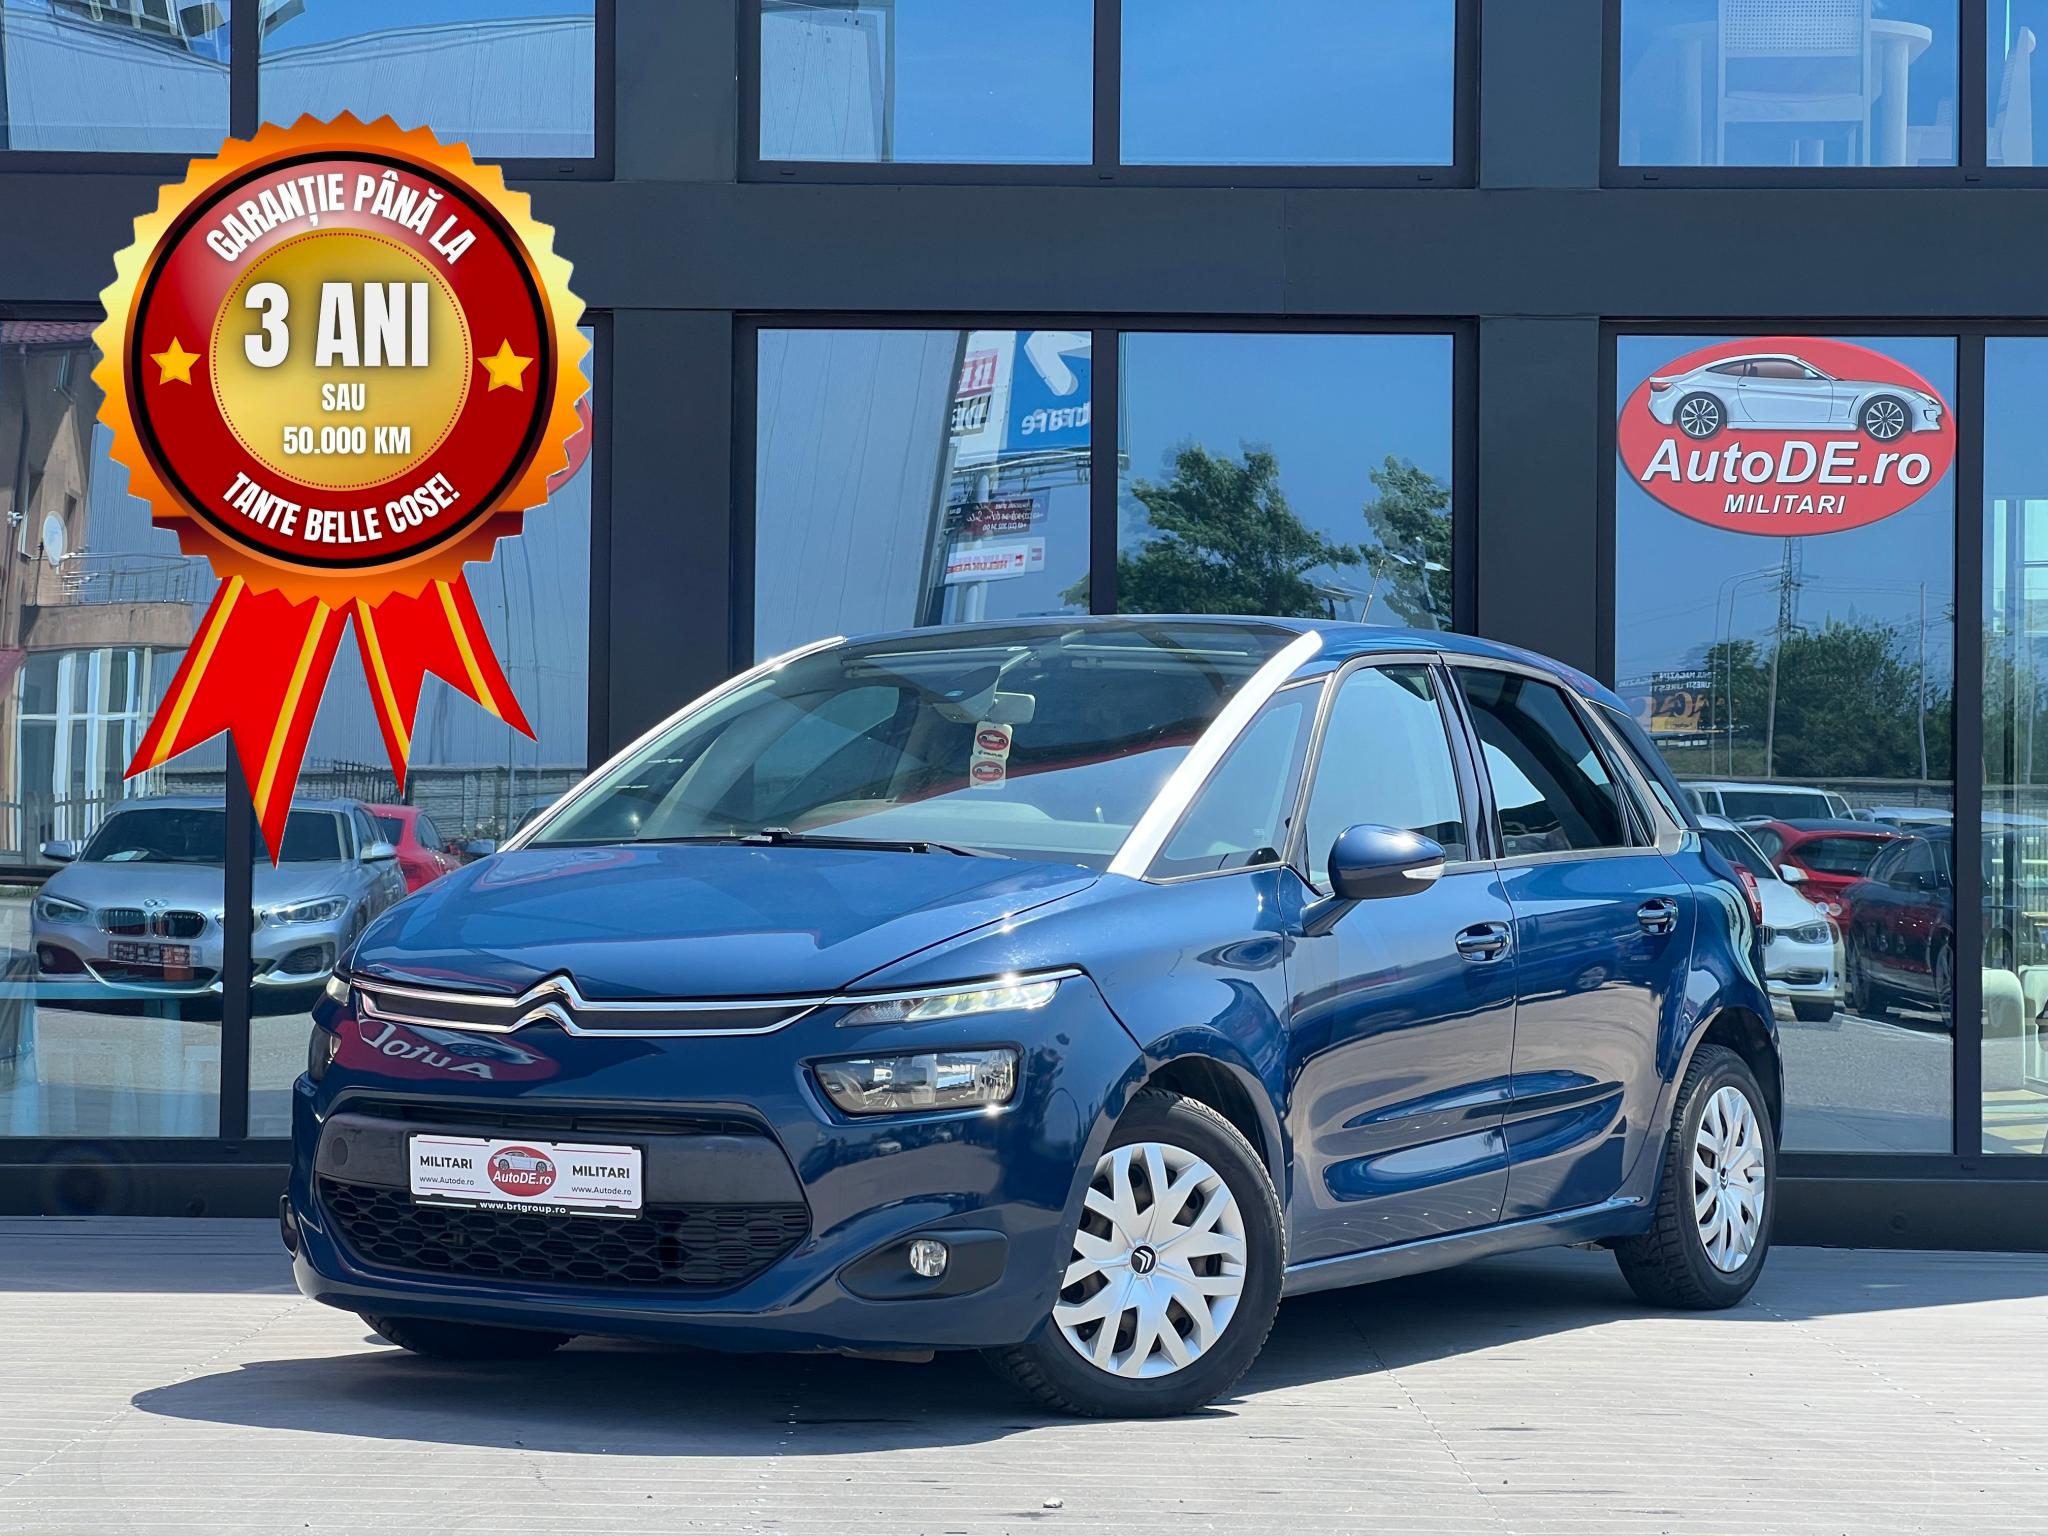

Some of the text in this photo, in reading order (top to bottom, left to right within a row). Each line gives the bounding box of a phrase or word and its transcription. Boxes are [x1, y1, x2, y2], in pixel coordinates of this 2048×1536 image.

[1640, 438, 1931, 486] AutoDE.ro
[1723, 494, 1847, 515] MILITARI
[420, 1155, 473, 1170] MILITARI
[492, 1170, 552, 1187] AutoDE.ro
[572, 1164, 630, 1179] MILITARI
[419, 1175, 475, 1186] www.Autode.ro
[571, 1185, 632, 1196] www.Autode.ro
[480, 1201, 567, 1215] www.brtgroup.ro
